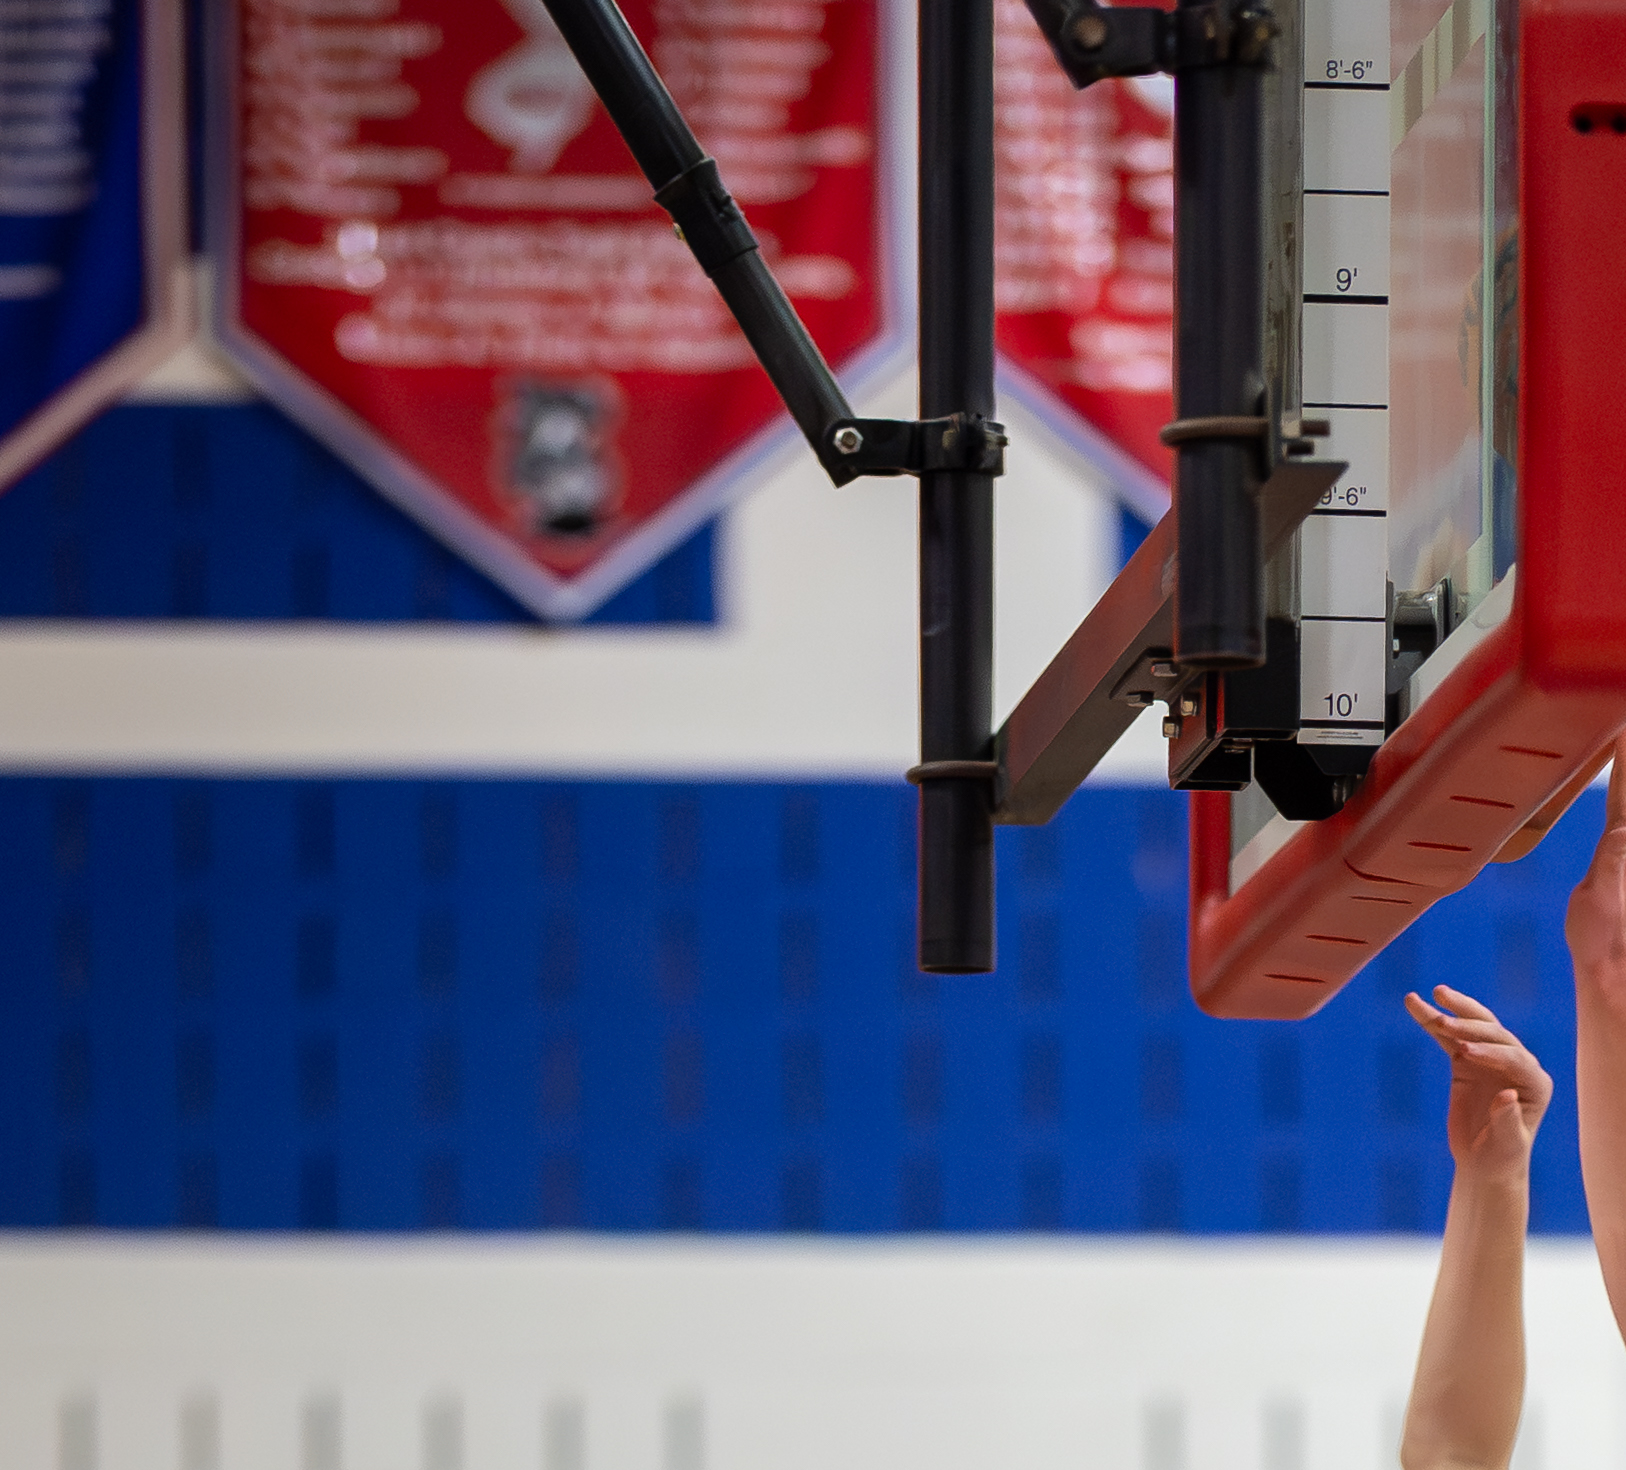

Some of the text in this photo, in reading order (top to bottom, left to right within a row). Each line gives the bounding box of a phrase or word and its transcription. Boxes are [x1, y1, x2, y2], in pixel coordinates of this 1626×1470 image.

[1326, 59, 1373, 80] 8'-6"
[1336, 266, 1358, 292] 9'
[1324, 692, 1358, 717] 10'
